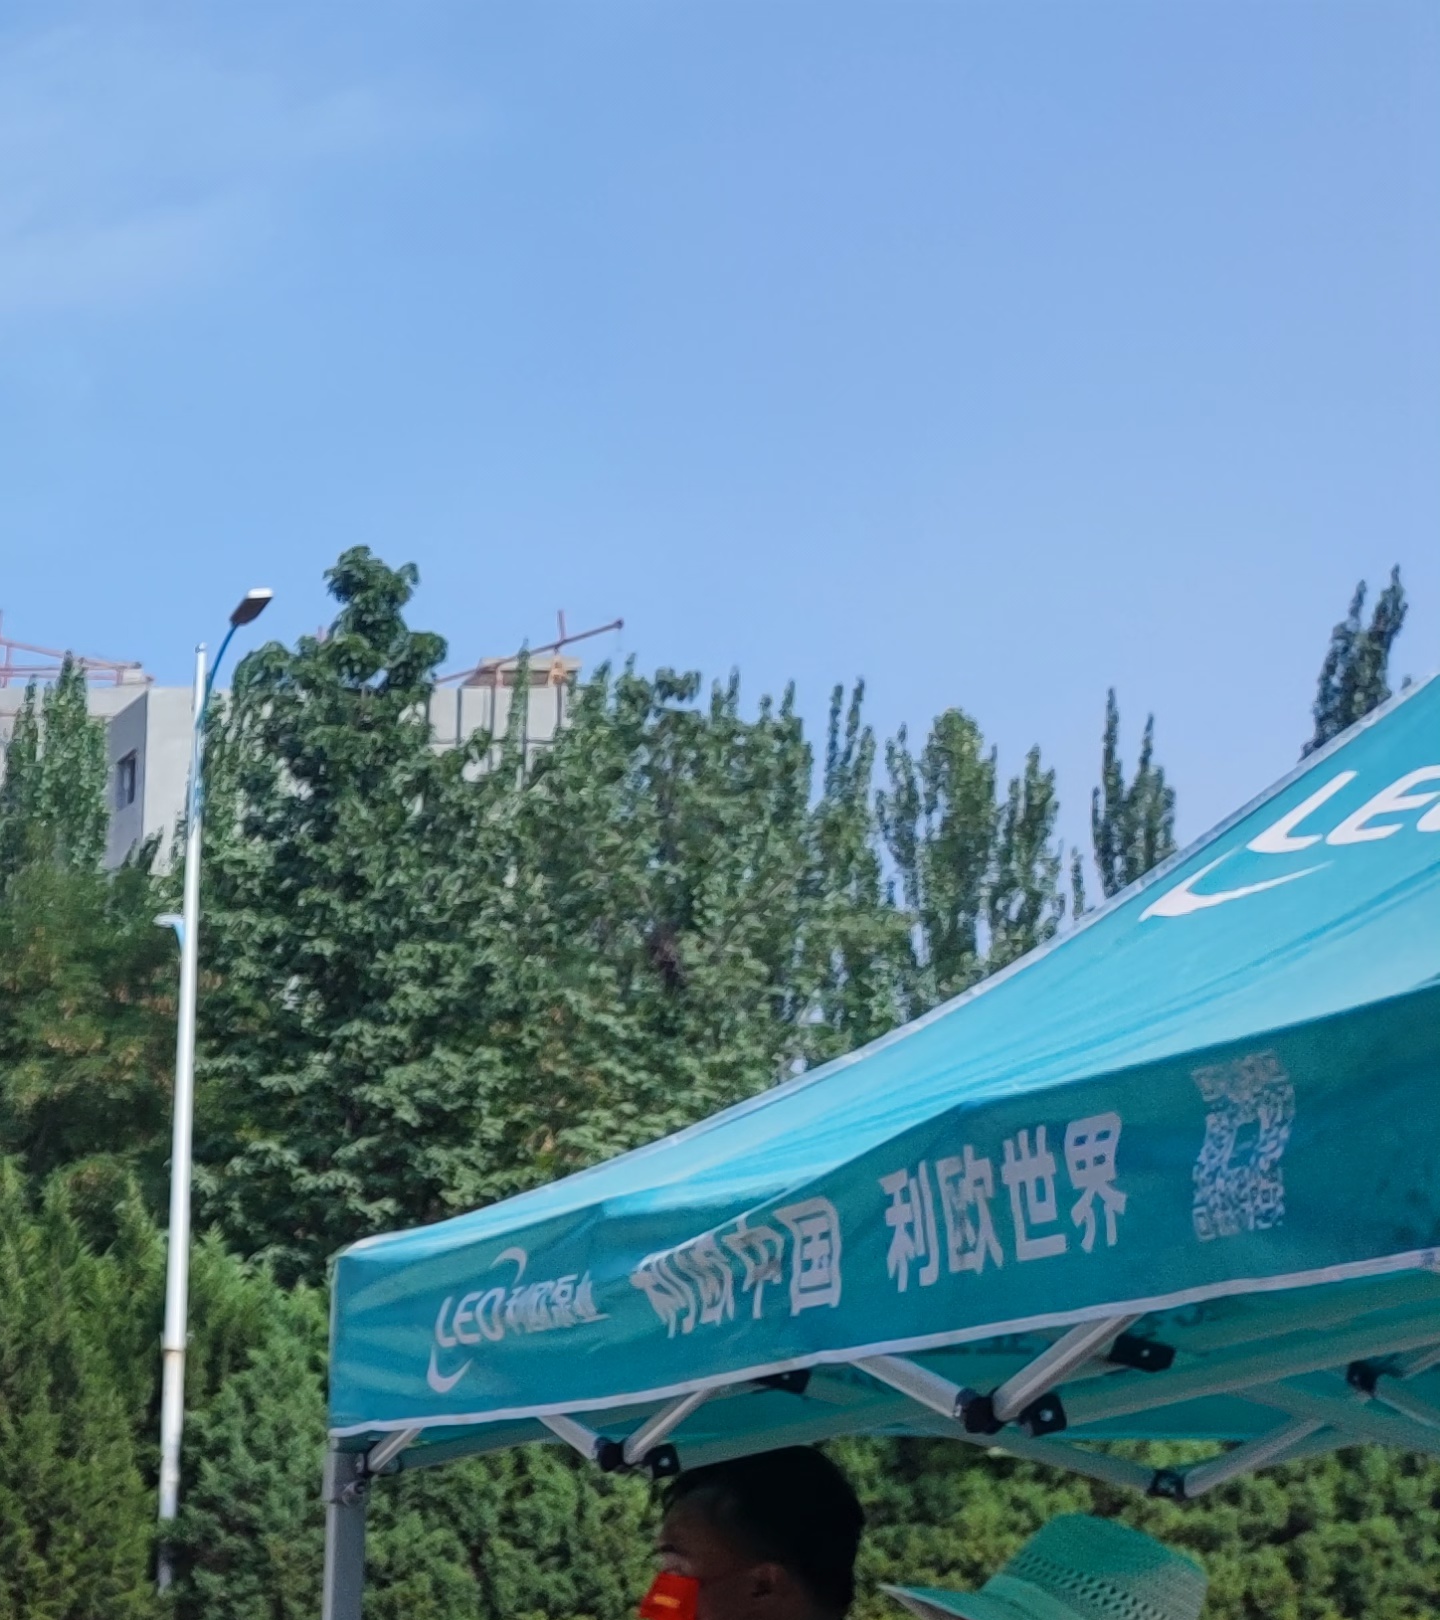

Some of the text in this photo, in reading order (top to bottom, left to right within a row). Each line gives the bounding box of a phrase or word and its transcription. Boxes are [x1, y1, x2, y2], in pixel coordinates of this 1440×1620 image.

[1246, 764, 1440, 854] LE
[877, 1111, 1128, 1293] 利欧世界
[435, 1286, 507, 1348] LEO
